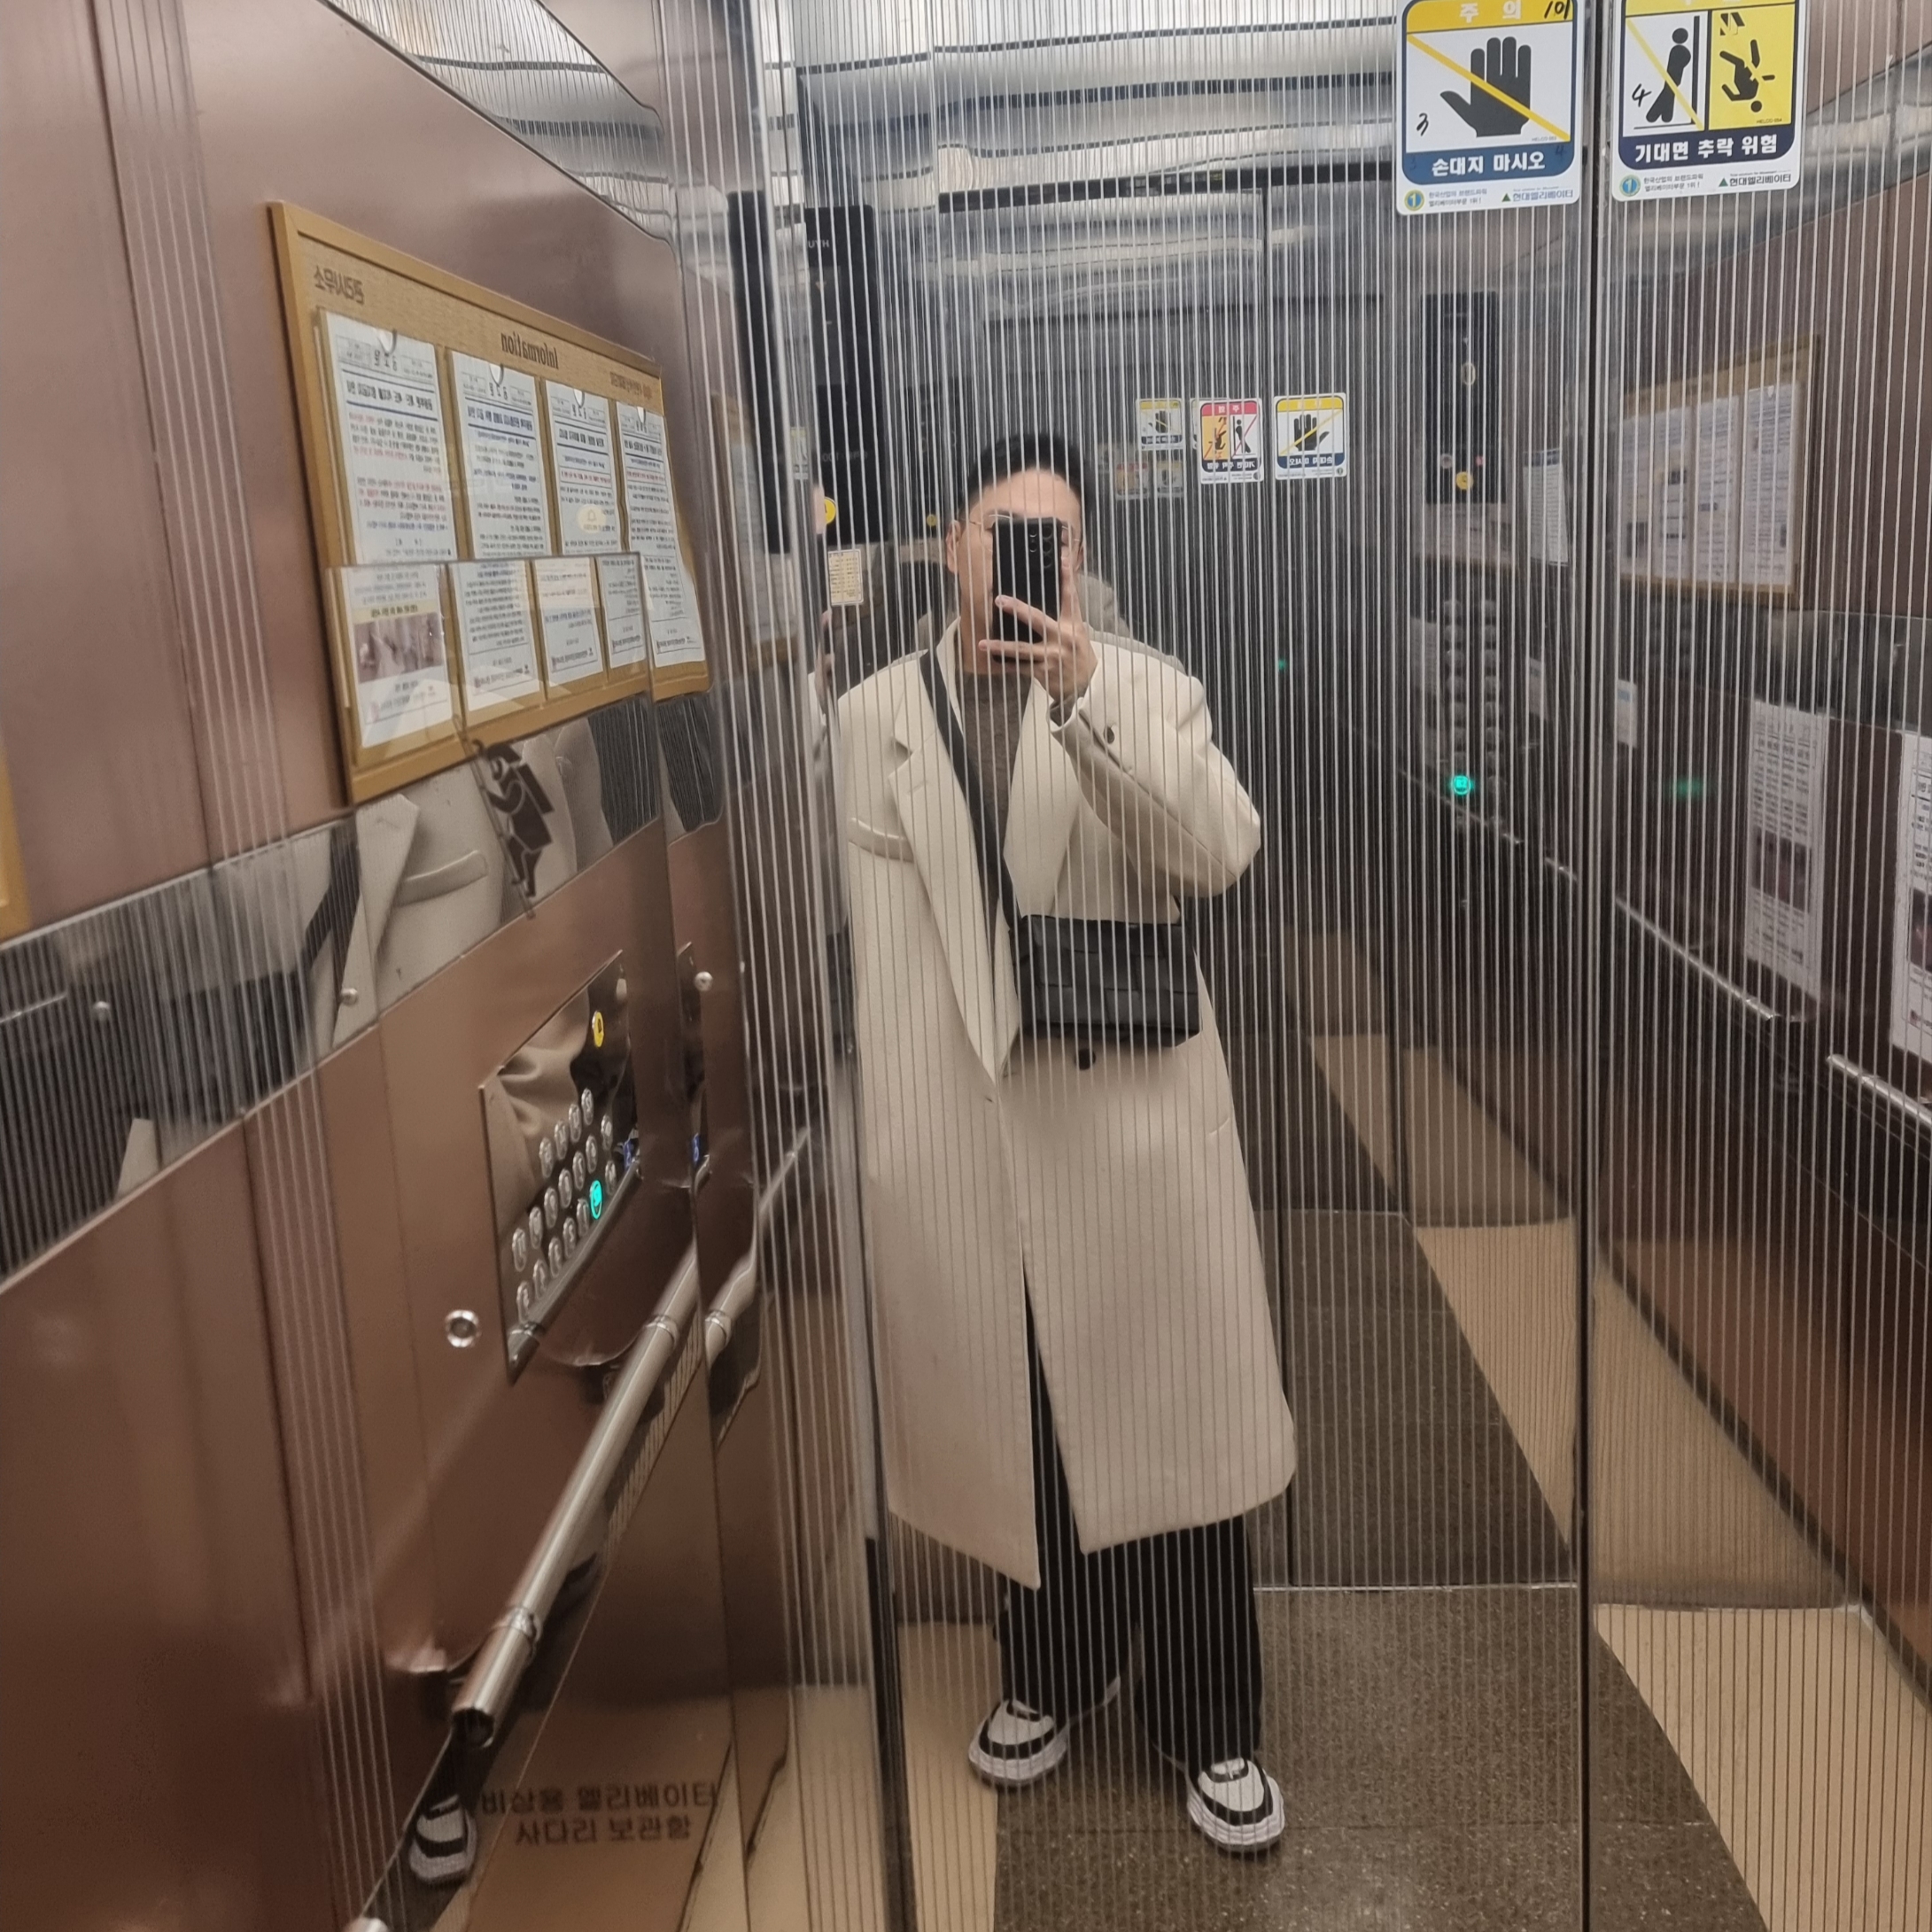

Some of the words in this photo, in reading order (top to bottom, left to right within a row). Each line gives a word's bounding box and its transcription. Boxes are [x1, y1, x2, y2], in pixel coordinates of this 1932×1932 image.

[1635, 140, 1688, 163] 기대면
[1697, 137, 1734, 159] 추락
[1742, 134, 1777, 155] 위험
[1432, 155, 1484, 176] 손대지
[1494, 151, 1545, 172] 마시오
[1729, 174, 1791, 187] 현대엘리베이터
[1512, 189, 1573, 202] 현대엘리베이터
[480, 1788, 564, 1815] 비상용
[577, 1781, 718, 1812] 엘리베이터
[515, 1818, 598, 1847] 사다리
